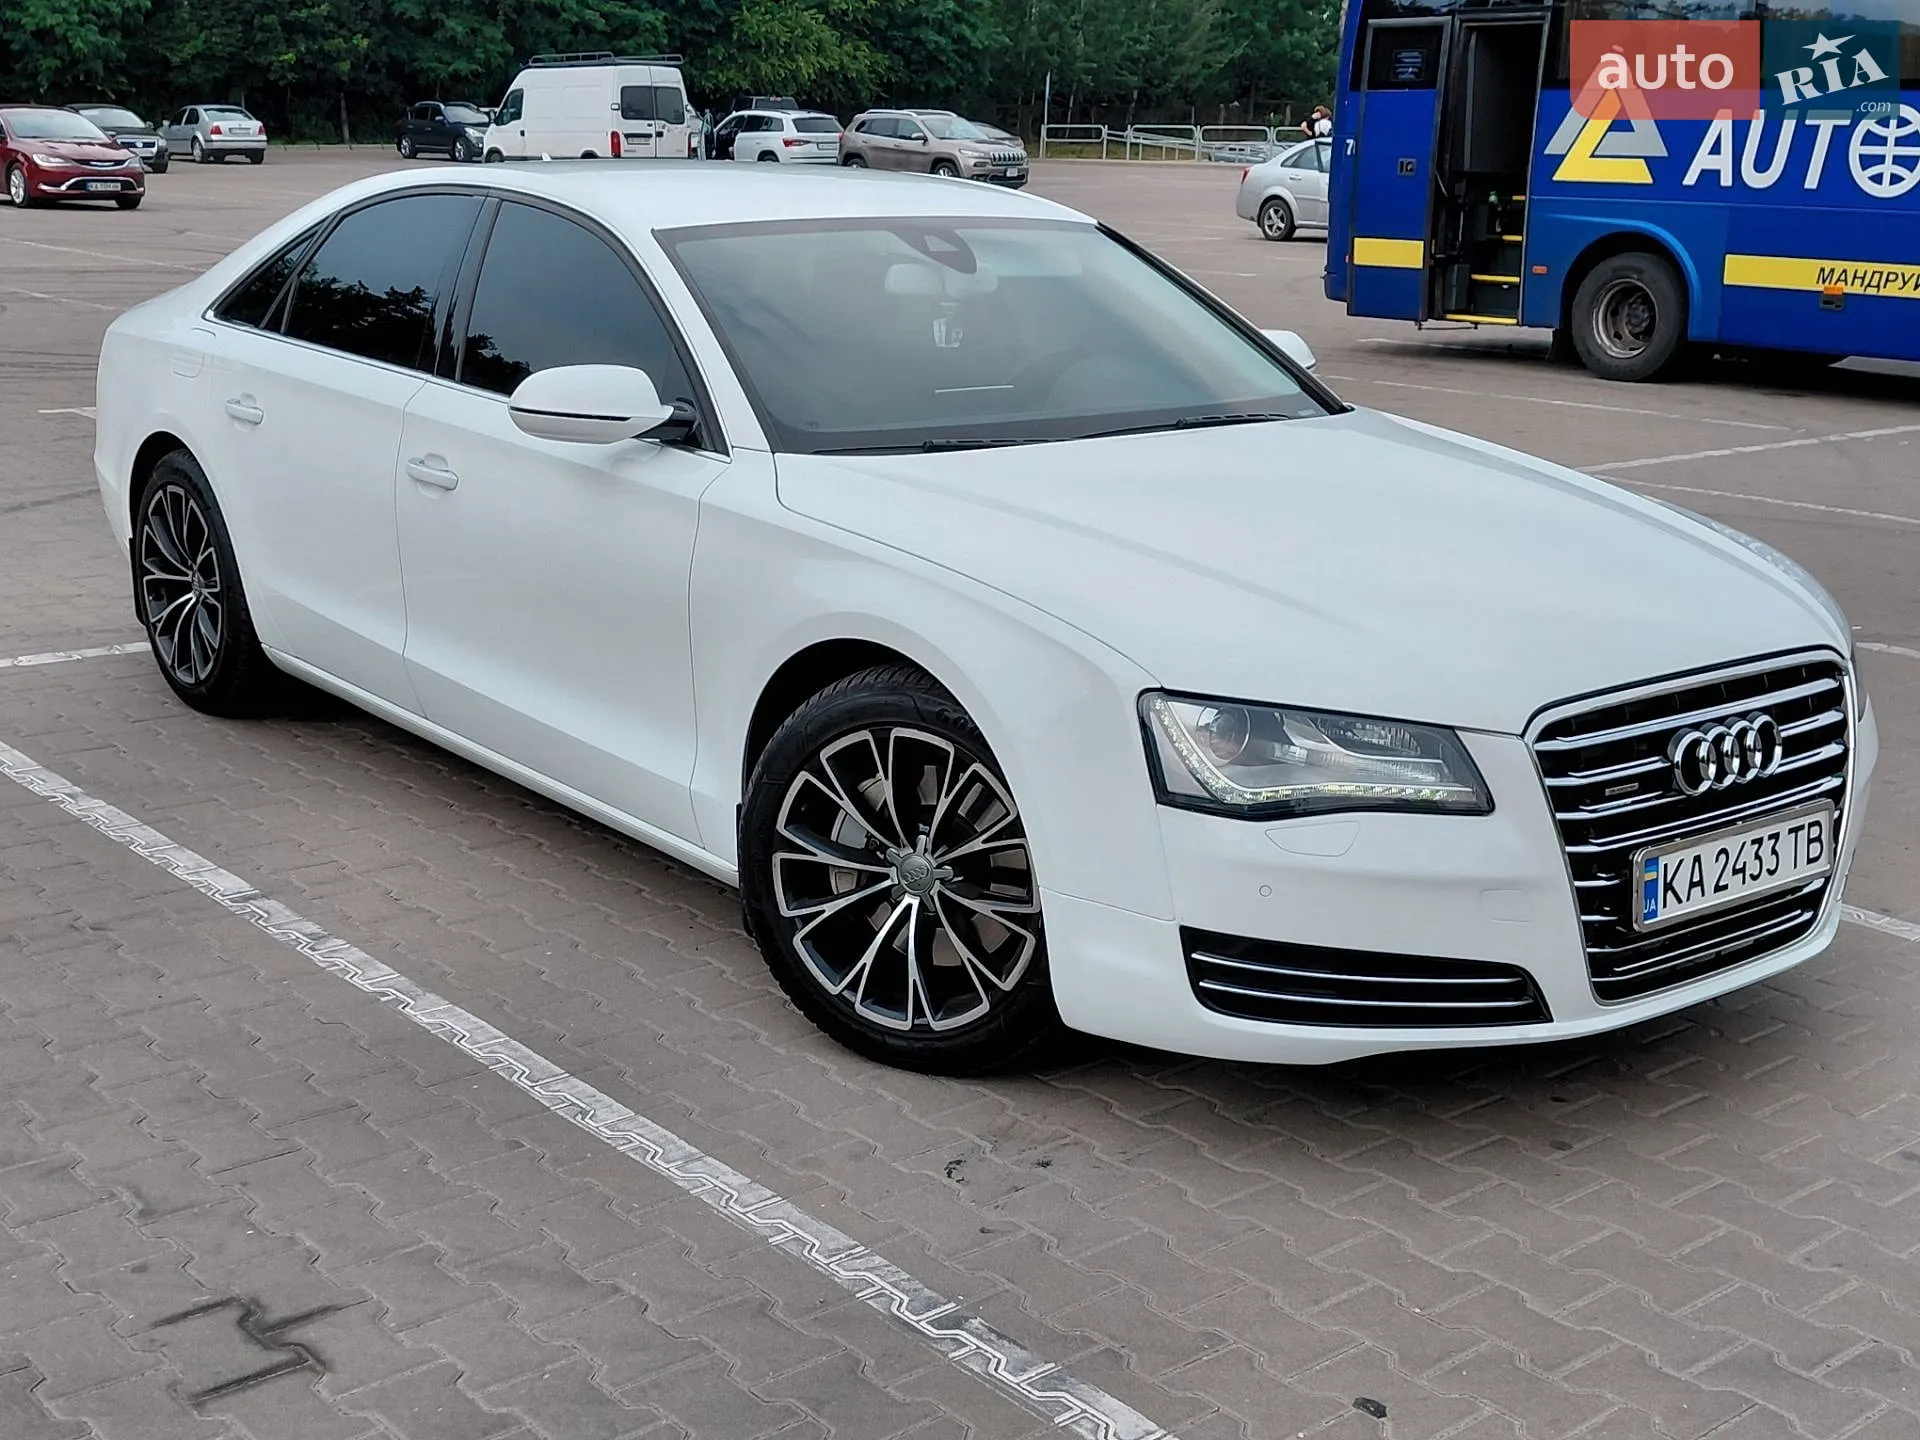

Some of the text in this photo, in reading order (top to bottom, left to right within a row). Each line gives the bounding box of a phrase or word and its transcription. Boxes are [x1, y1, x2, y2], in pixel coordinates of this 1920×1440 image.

[1345, 138, 1356, 156] 7
[1662, 820, 1824, 909] KA 2433 TB
